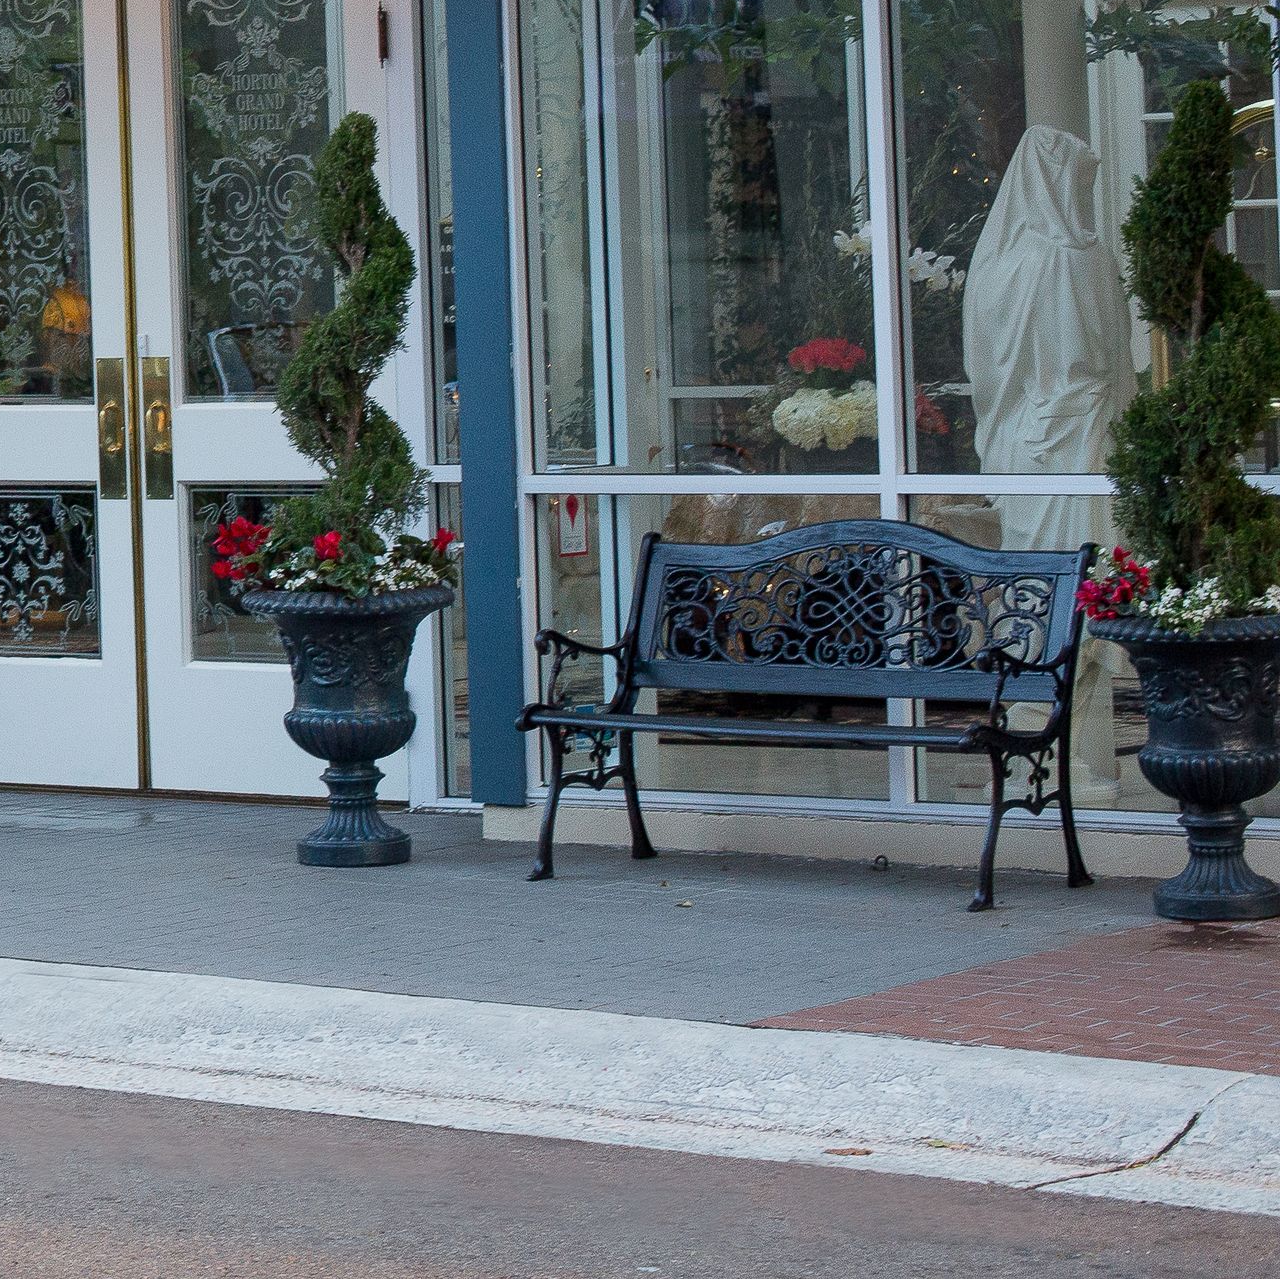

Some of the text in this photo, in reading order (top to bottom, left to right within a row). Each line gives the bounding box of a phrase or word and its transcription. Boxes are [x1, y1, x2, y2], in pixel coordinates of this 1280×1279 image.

[232, 73, 289, 92] HORTON
[236, 92, 286, 111] GRAND
[238, 113, 284, 131] HOTEL
